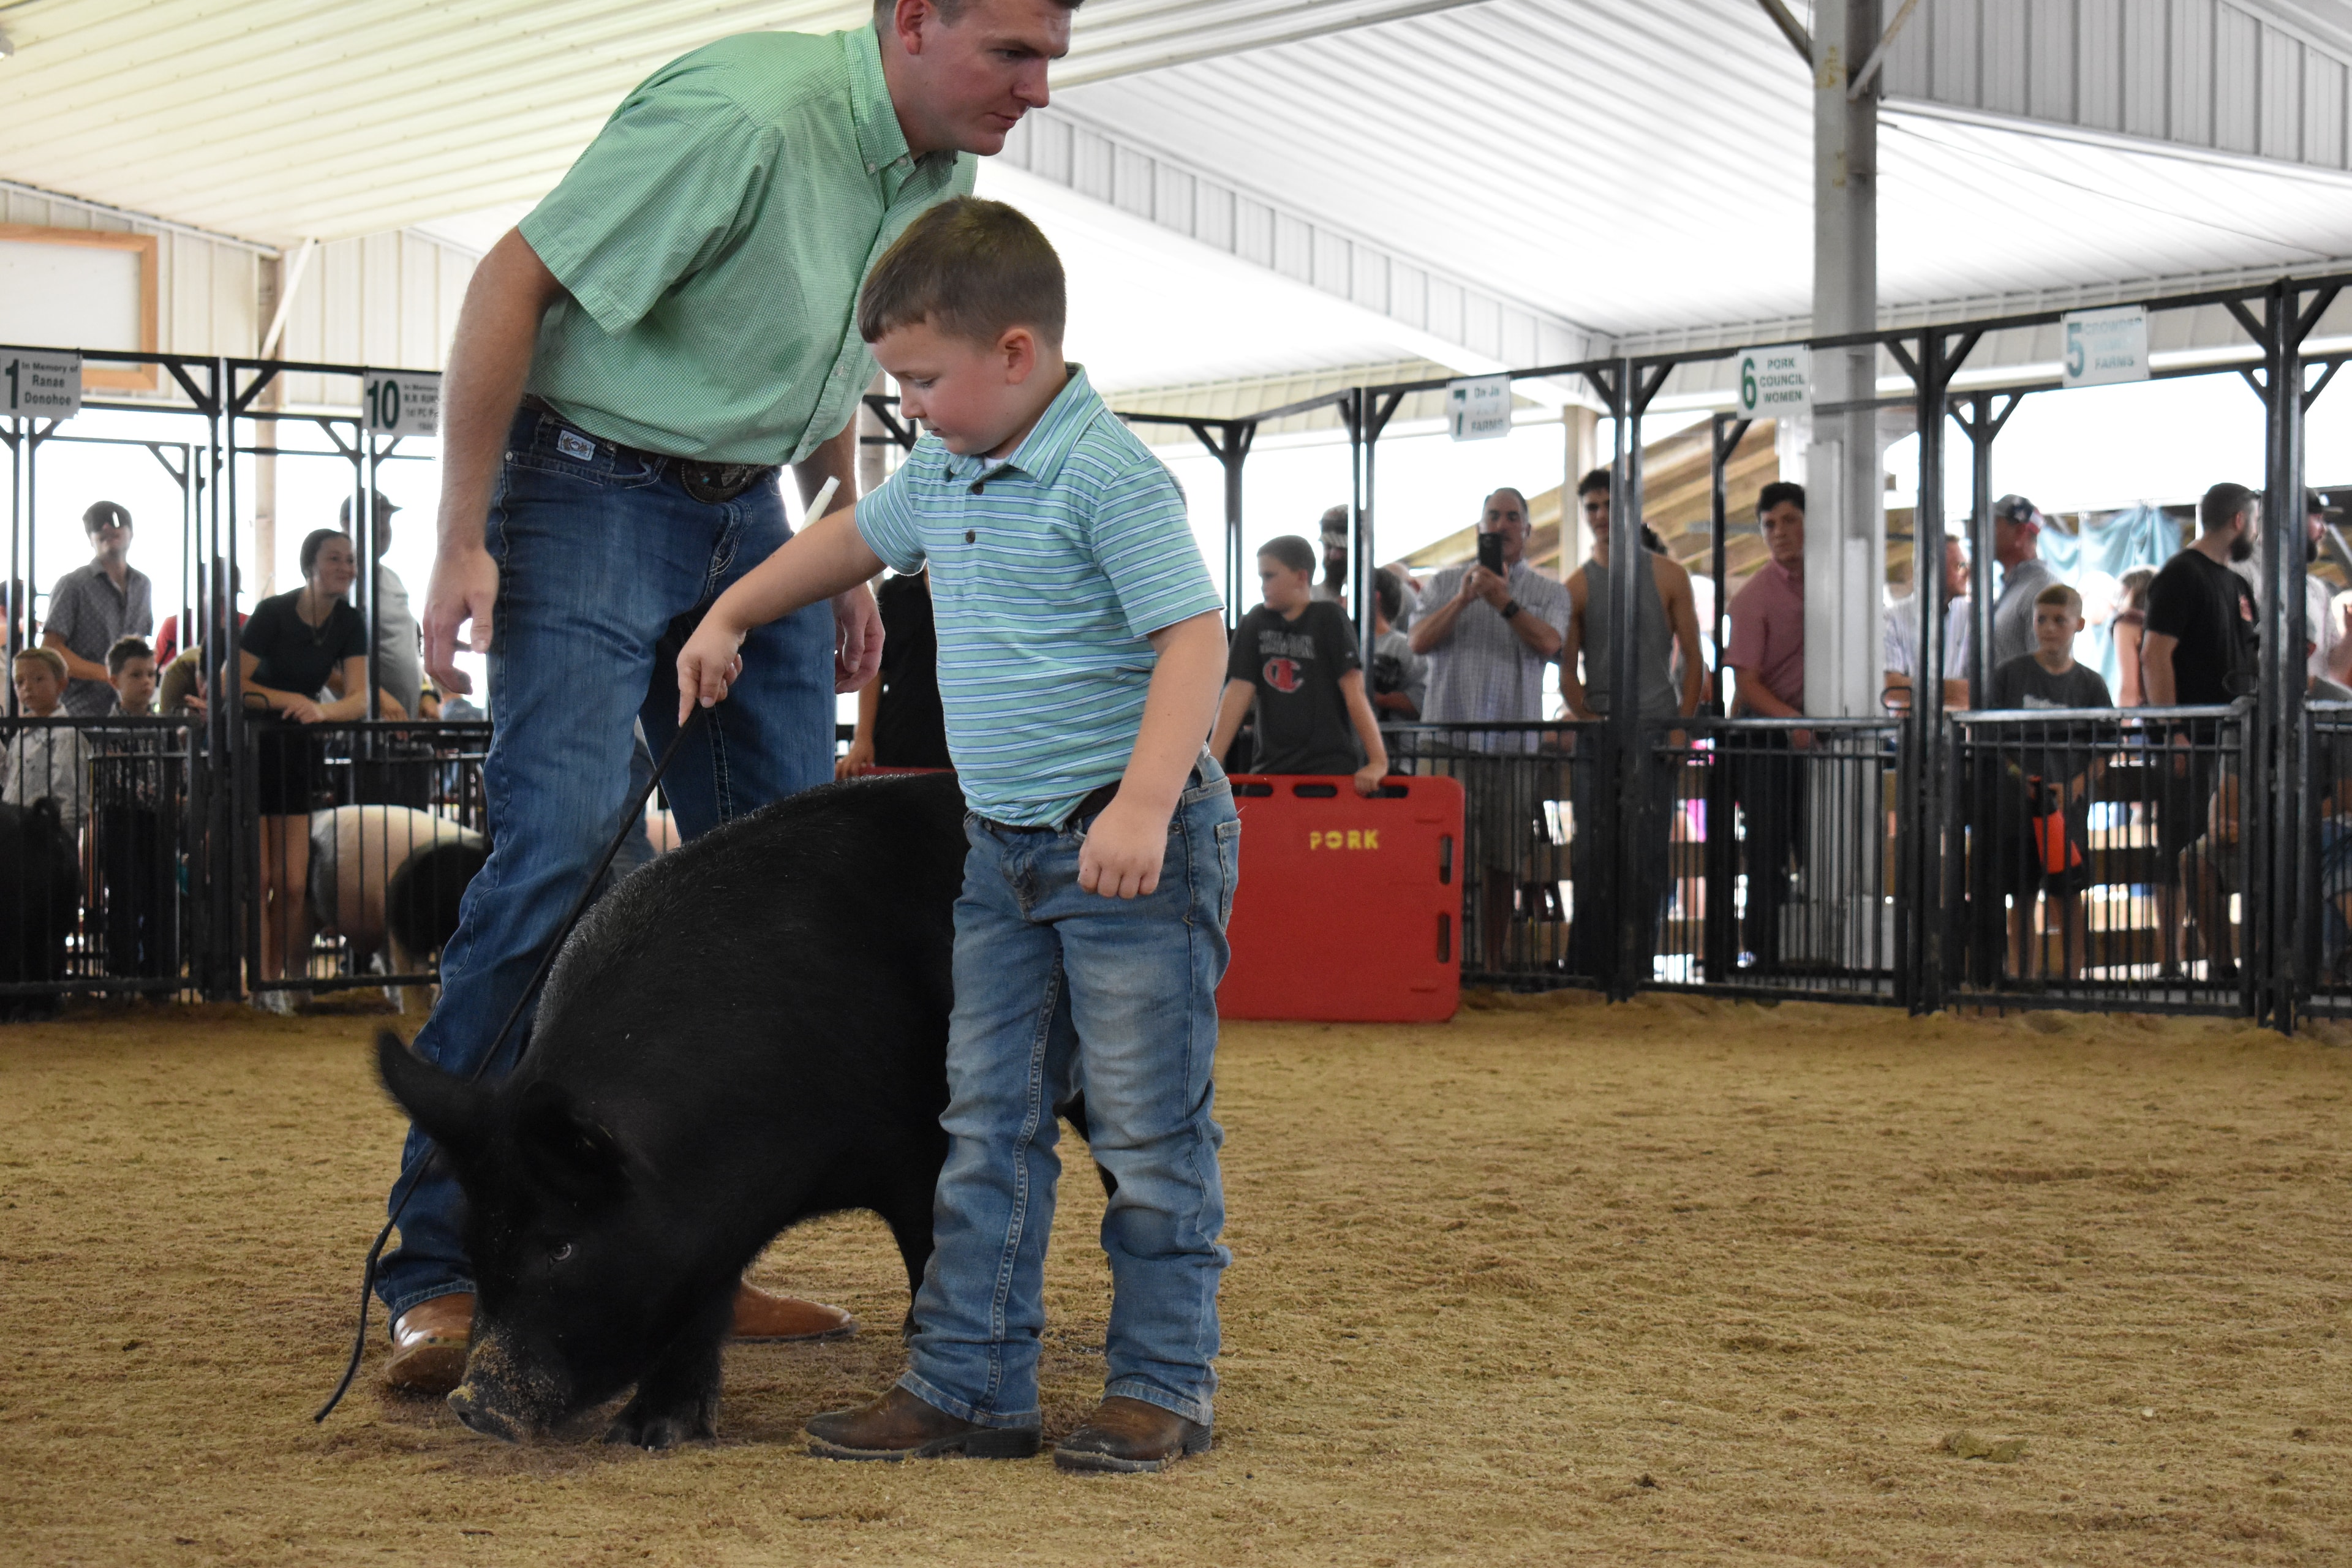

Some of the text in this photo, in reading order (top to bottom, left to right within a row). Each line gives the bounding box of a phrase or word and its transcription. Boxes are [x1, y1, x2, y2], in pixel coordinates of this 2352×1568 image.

[2067, 322, 2084, 378] 5
[32, 363, 67, 374] Memory
[1767, 358, 1795, 370] PORK
[2094, 356, 2135, 371] FARMS
[0, 358, 19, 409] 1
[1741, 357, 1757, 410] 6
[1760, 374, 1805, 388] COUNCIL
[24, 392, 72, 405] Donohoe
[367, 379, 400, 429] 10
[1763, 391, 1802, 402] WOMEN
[1453, 389, 1466, 436] 7
[1310, 829, 1379, 850] PORK
